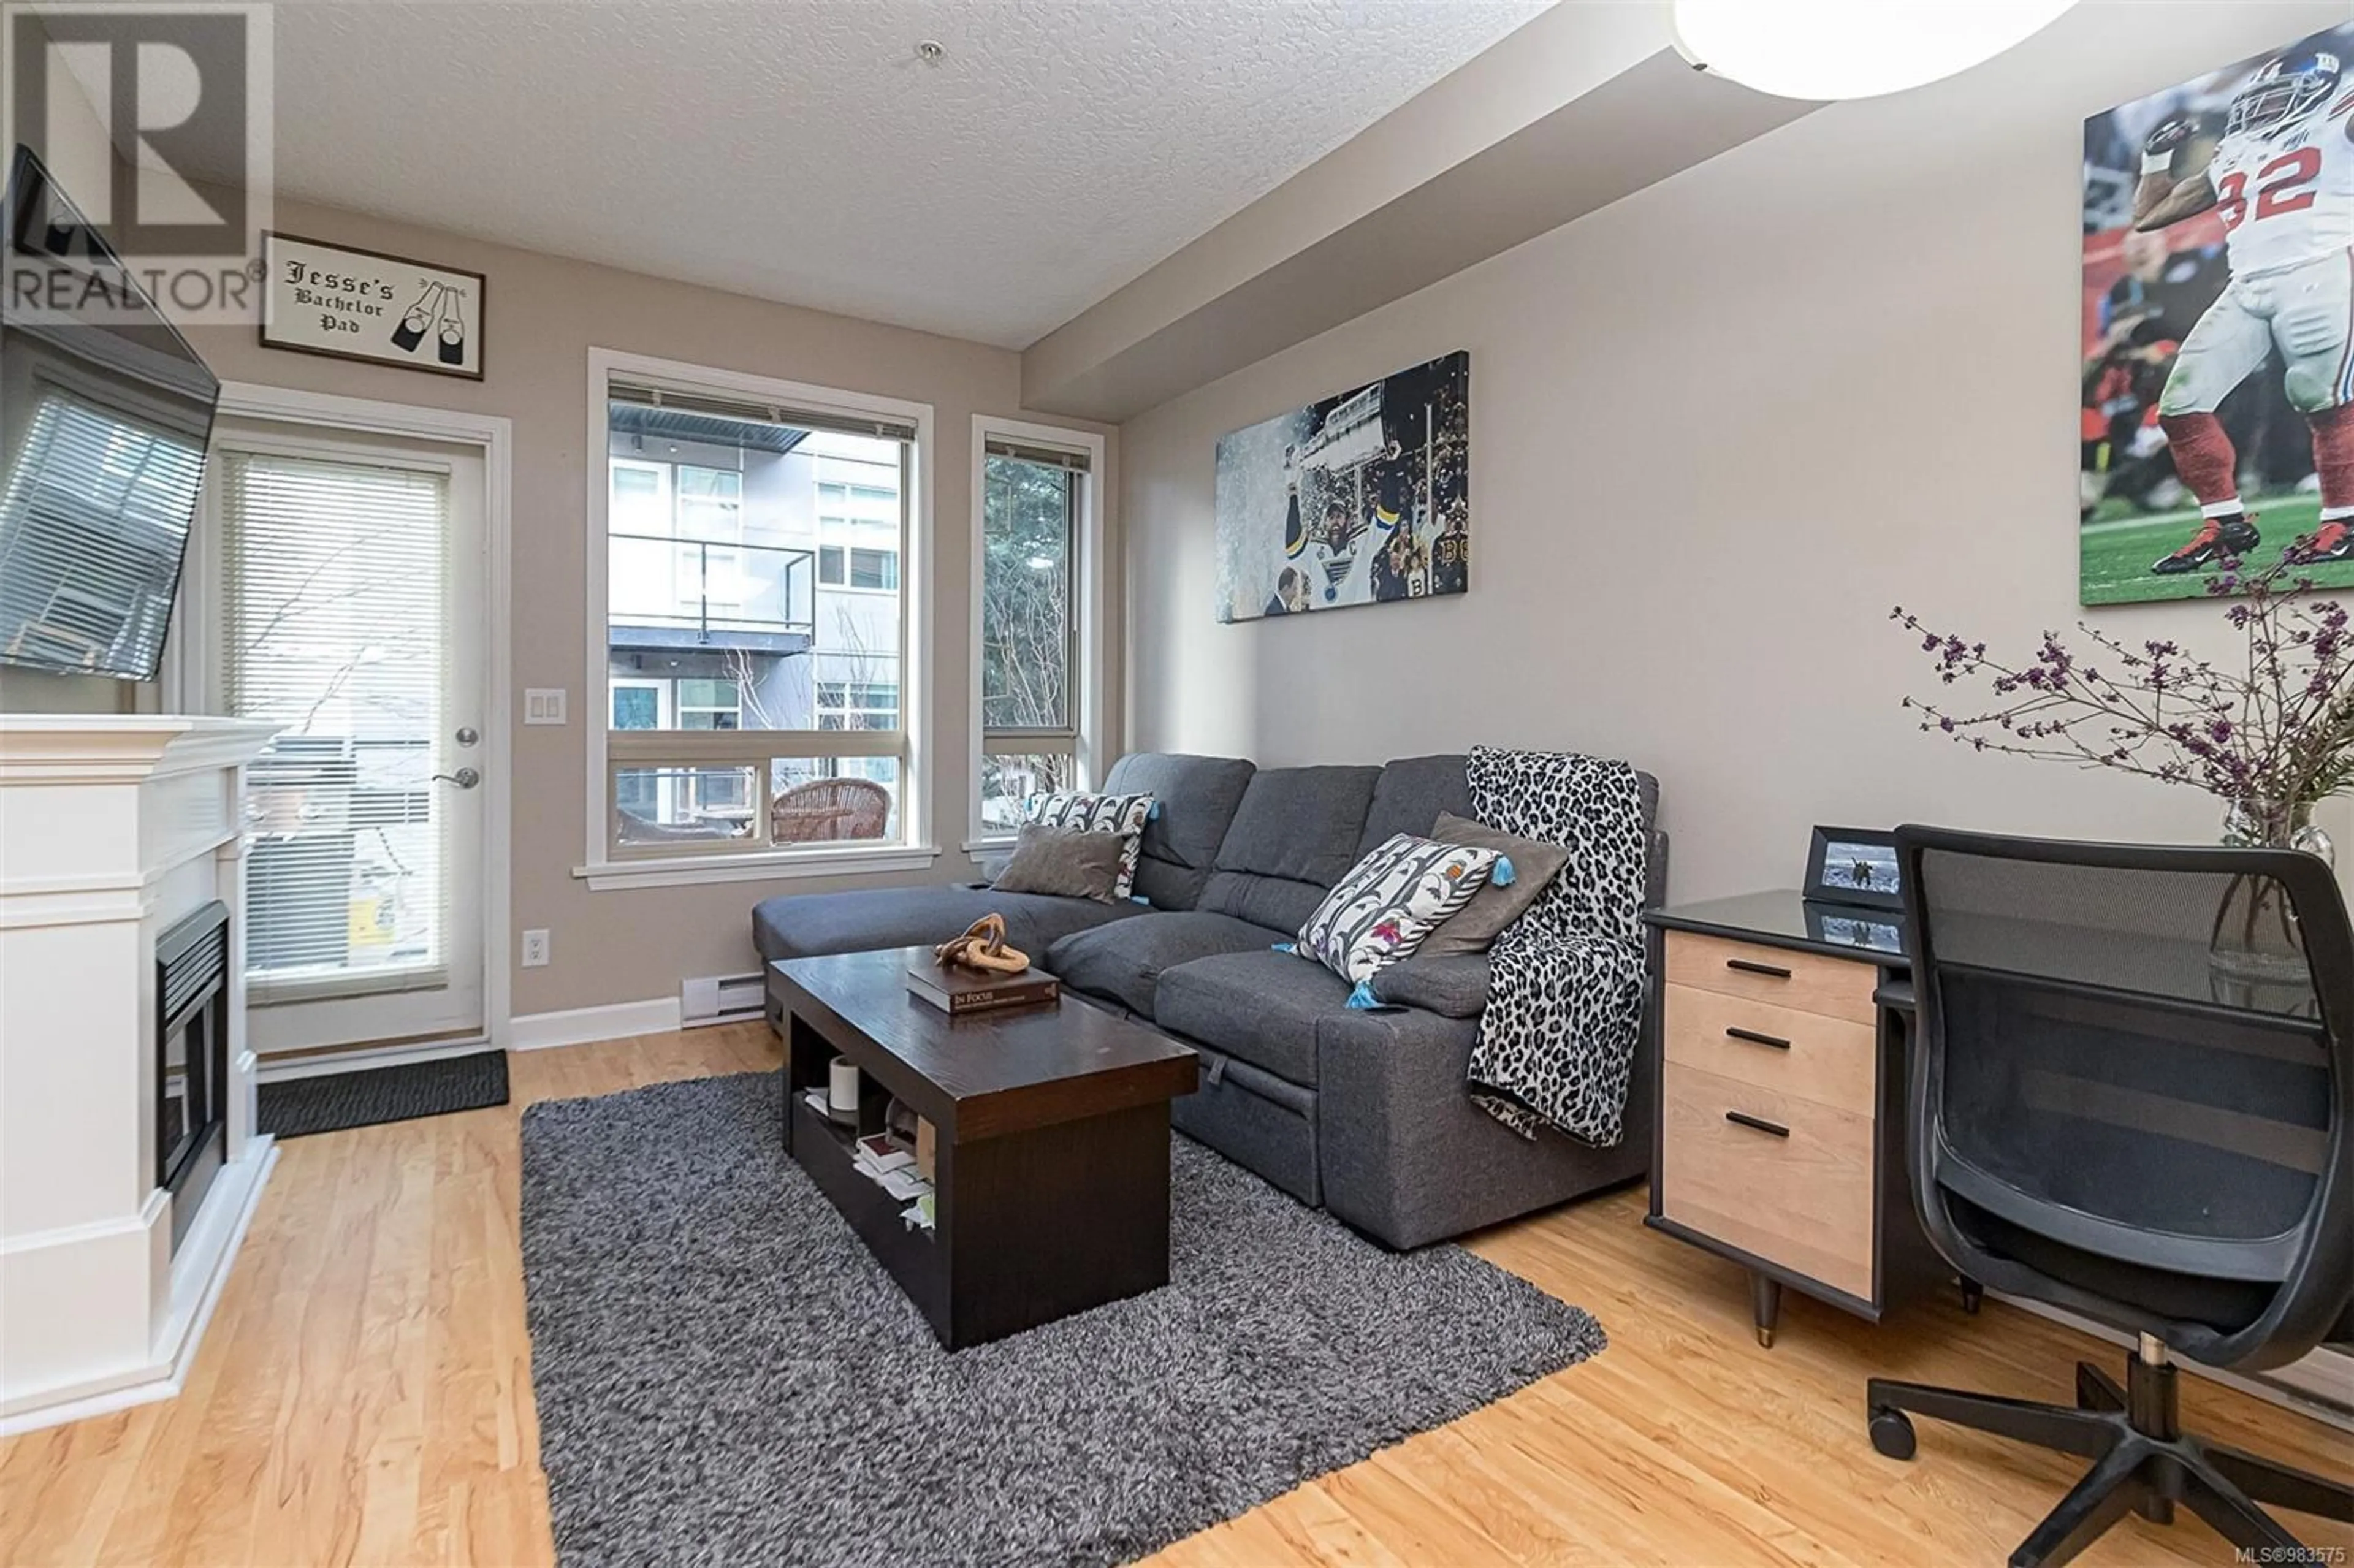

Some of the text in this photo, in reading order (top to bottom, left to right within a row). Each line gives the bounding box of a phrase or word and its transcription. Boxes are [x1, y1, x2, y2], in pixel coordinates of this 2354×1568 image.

[284, 260, 395, 300] Jesse's
[294, 287, 384, 317] Bachelor
[319, 313, 360, 333] Pad
